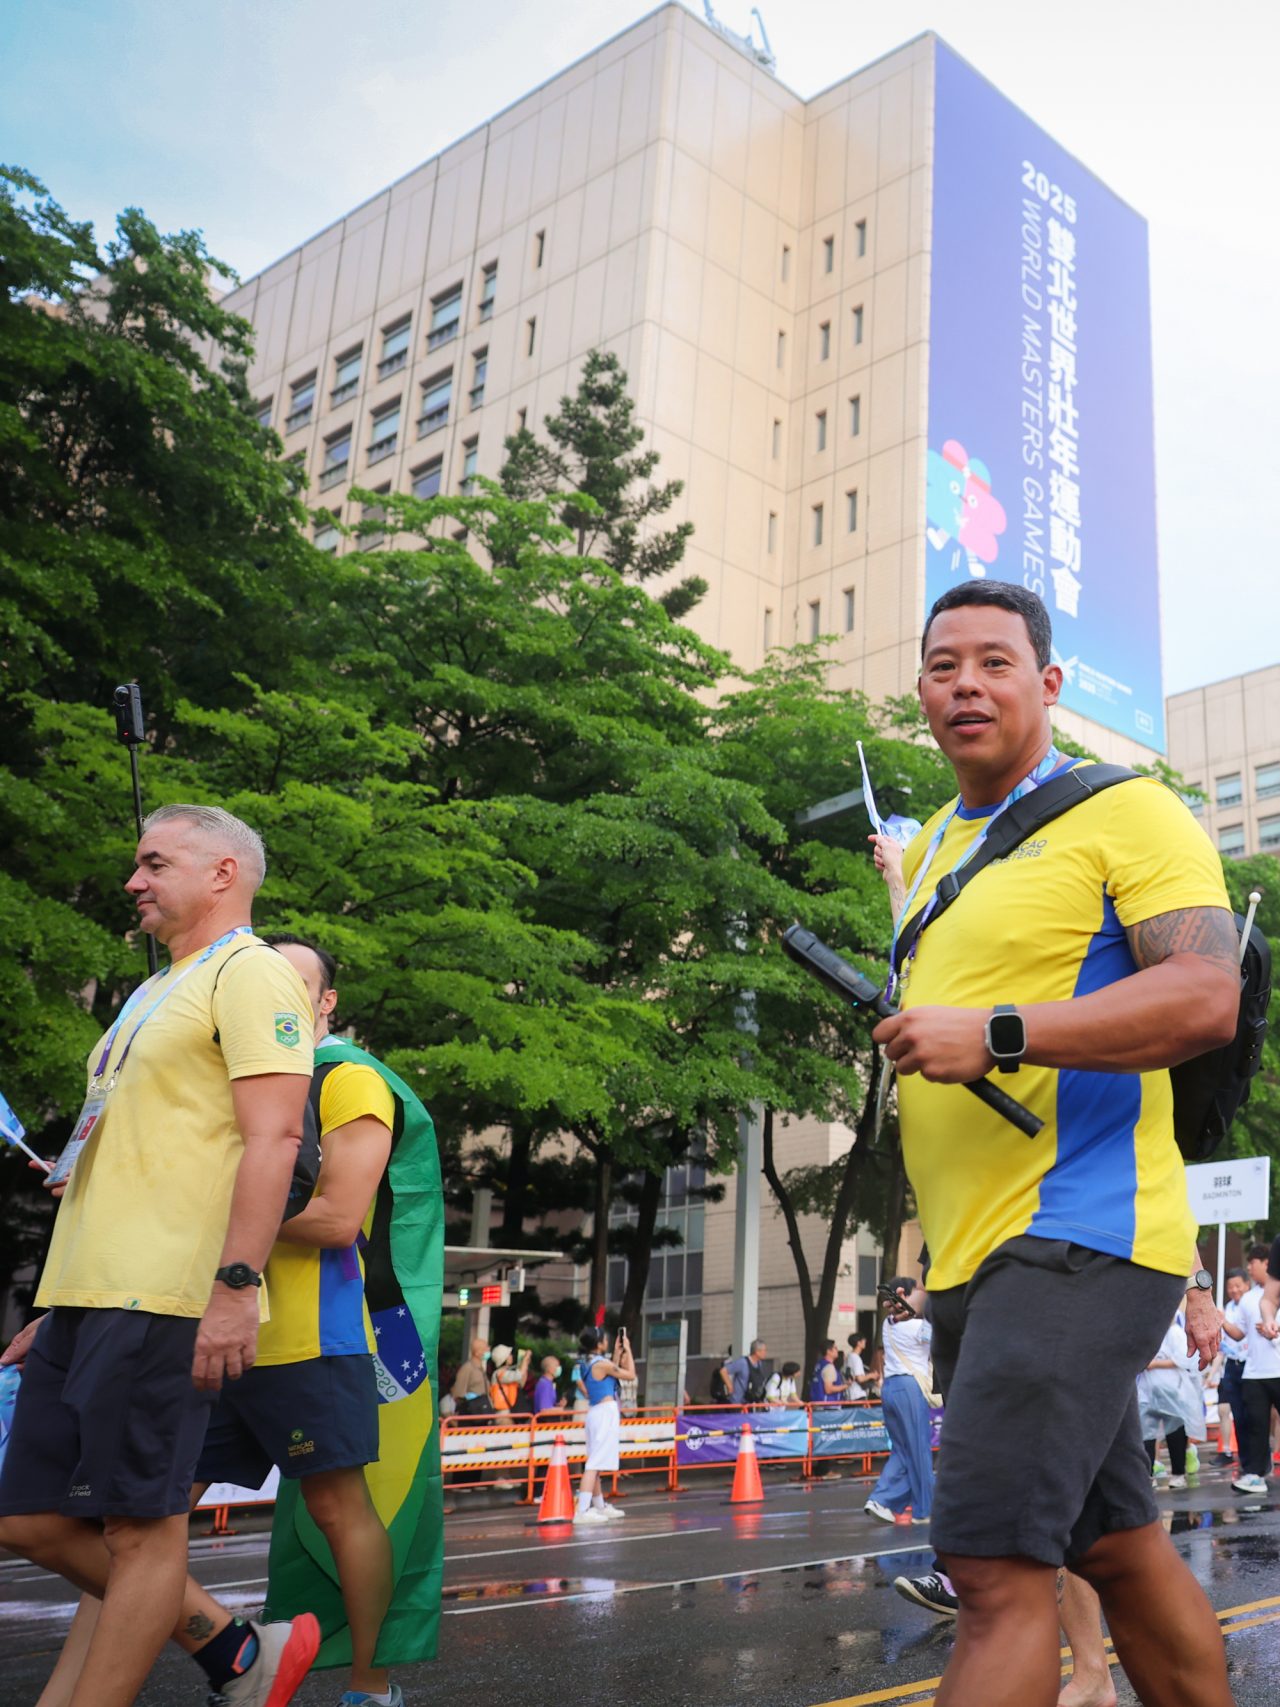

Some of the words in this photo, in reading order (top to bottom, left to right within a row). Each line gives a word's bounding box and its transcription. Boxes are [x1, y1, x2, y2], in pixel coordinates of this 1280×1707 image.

[1021, 159, 1077, 224] 2025
[1021, 198, 1042, 311] WORLD
[1022, 313, 1045, 470] MASTERS
[1046, 216, 1082, 619] 雙北世界壯年運動會
[1022, 476, 1046, 598] GAMES
